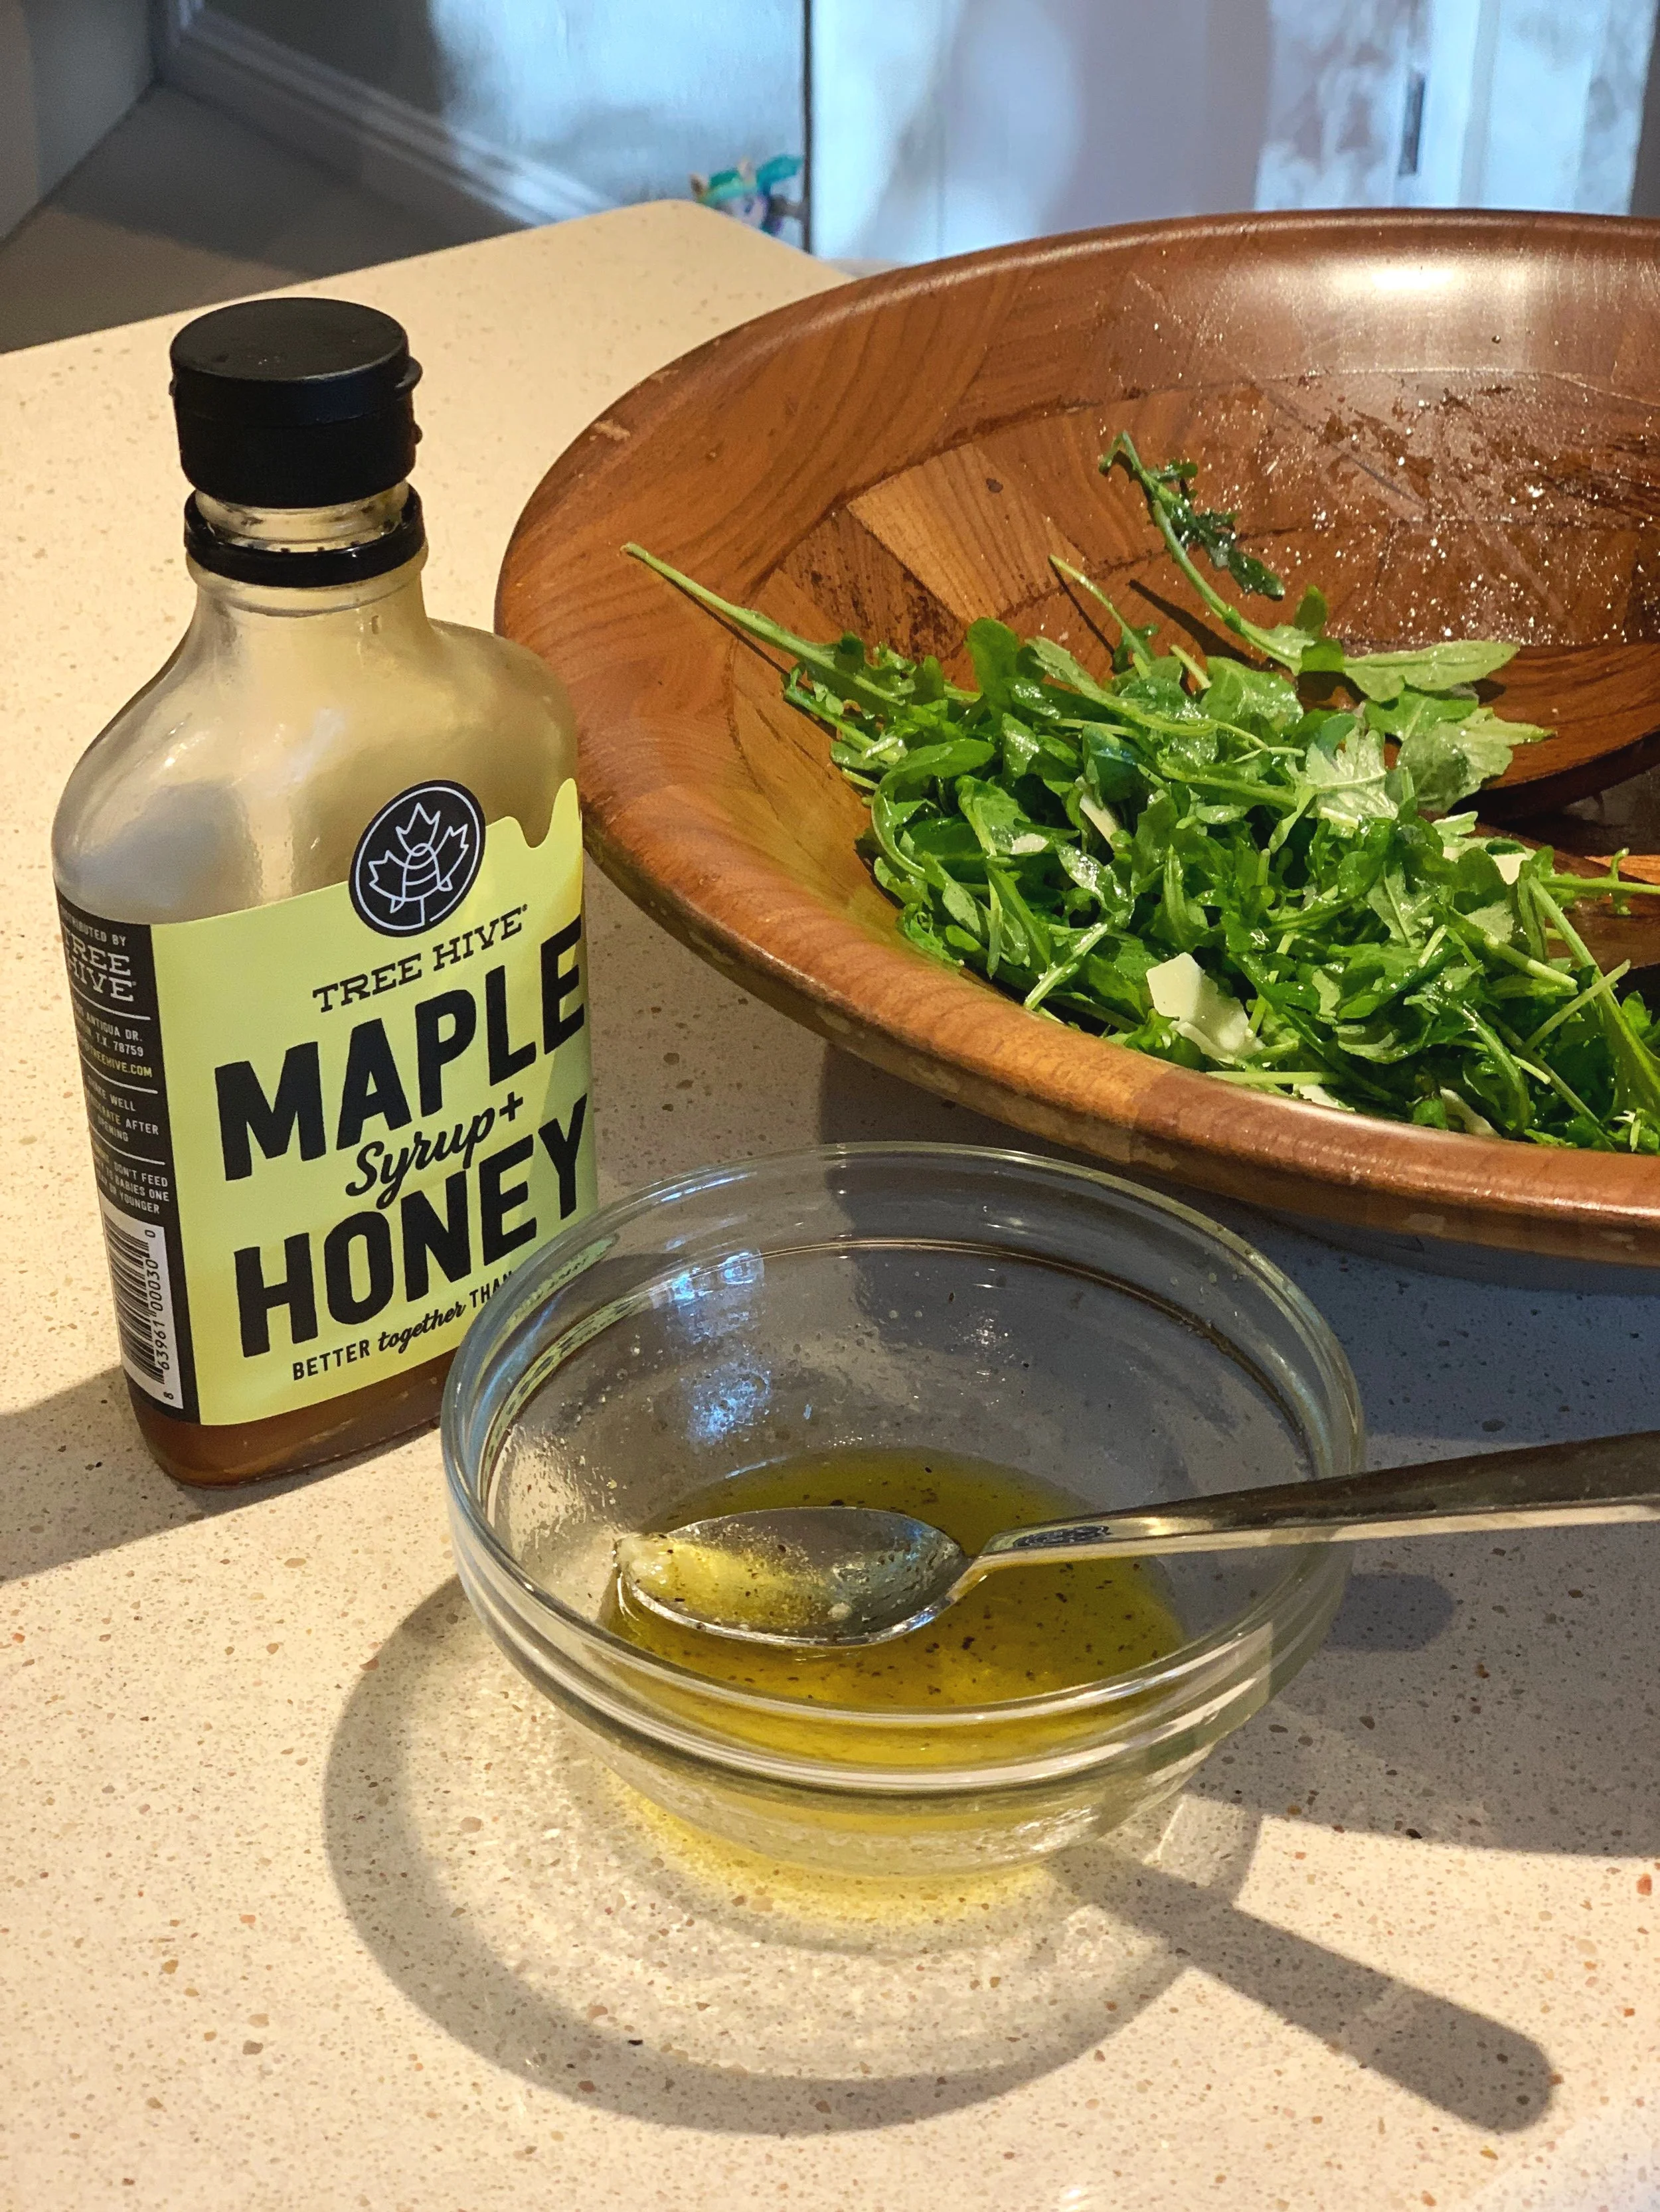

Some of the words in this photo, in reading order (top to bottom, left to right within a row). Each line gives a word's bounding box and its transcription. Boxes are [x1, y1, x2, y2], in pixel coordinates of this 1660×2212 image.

[112, 934, 126, 947] BY
[312, 953, 422, 1012] TREE
[113, 1040, 144, 1058] 78759
[214, 913, 585, 1182] MAPLE
[110, 1094, 136, 1111] WELL
[125, 1118, 159, 1135] AFTER
[115, 1175, 145, 1196] BABIES
[149, 1188, 170, 1202] ONE
[141, 1173, 168, 1187] FEED
[120, 1190, 160, 1214] YOUNGER
[234, 1093, 588, 1358] HONEY
[292, 1338, 371, 1381] BETTER
[377, 1301, 467, 1354] together
